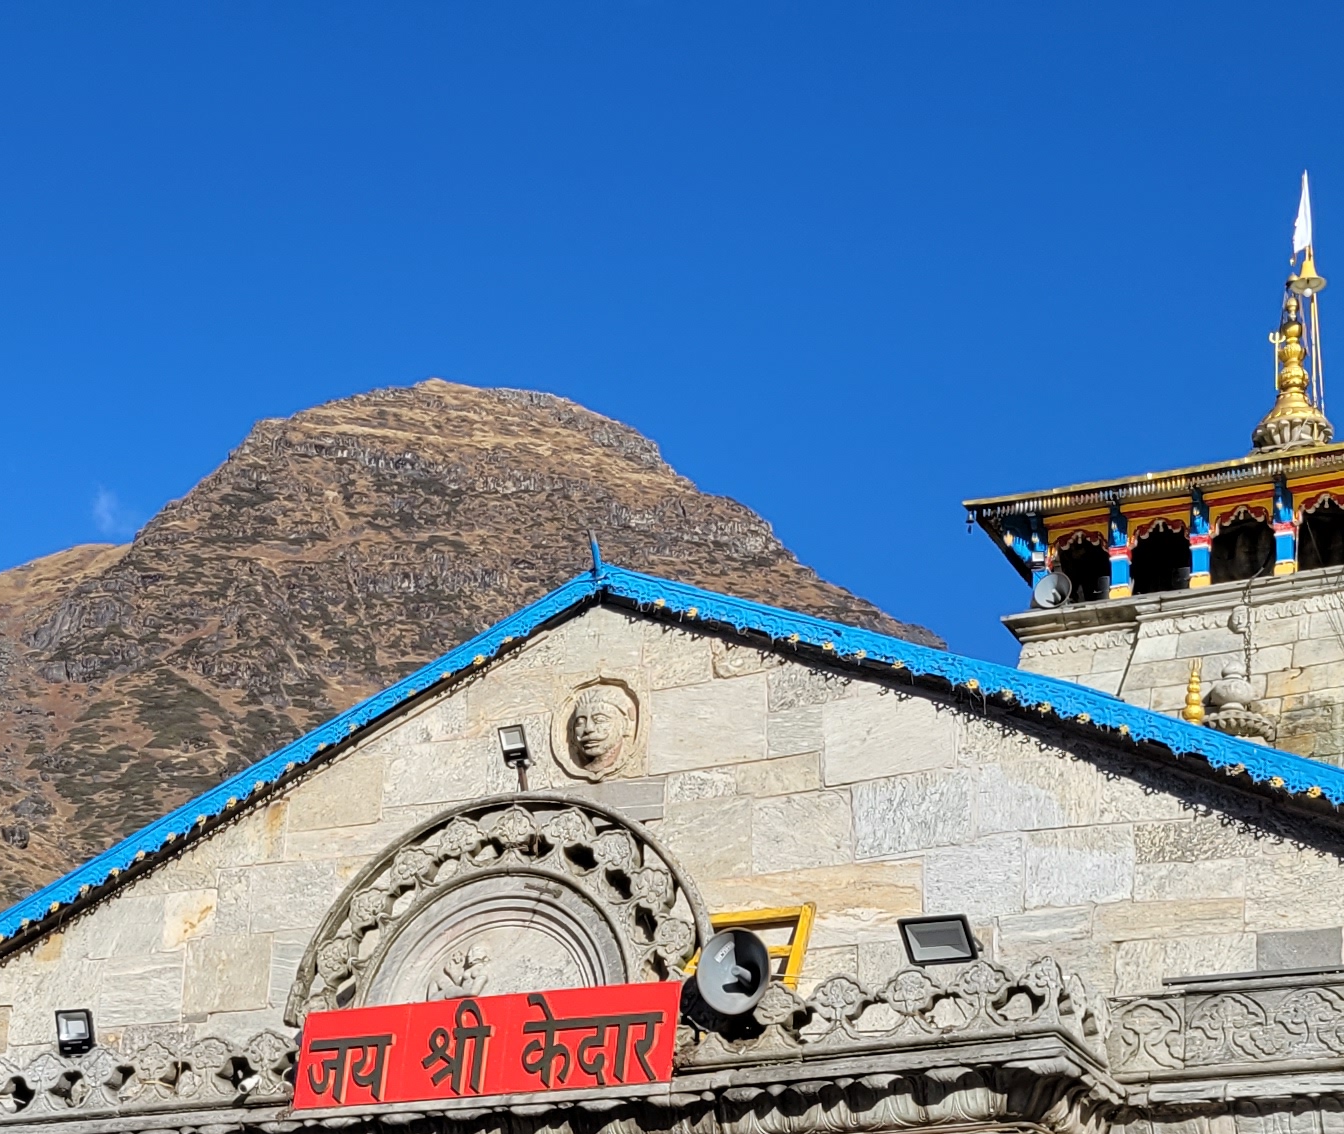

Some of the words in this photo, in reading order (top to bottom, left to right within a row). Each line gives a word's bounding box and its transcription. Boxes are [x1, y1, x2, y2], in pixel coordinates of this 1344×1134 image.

[308, 1034, 393, 1104] जय
[422, 999, 492, 1095] श्री
[522, 993, 664, 1088] केदार
